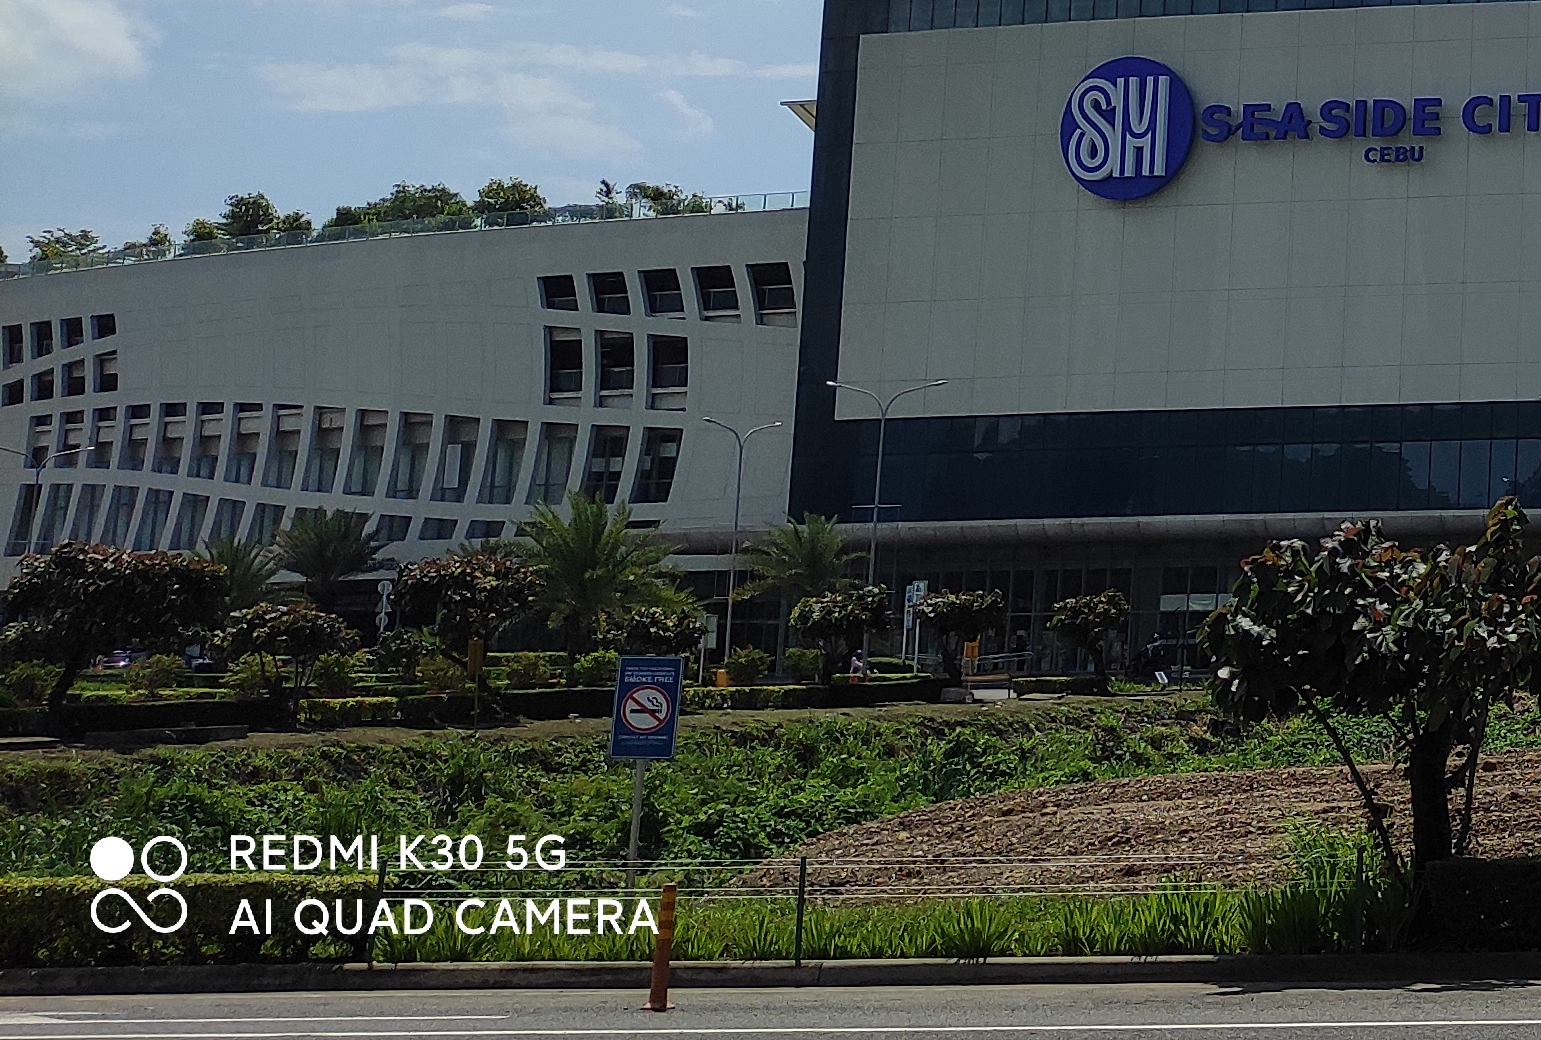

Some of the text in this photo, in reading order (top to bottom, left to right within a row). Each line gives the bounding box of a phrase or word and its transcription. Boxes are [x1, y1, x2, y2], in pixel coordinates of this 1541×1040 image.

[1068, 75, 1170, 181] SM
[1201, 98, 1443, 142] SEASIDE
[1363, 146, 1425, 164] CEBU
